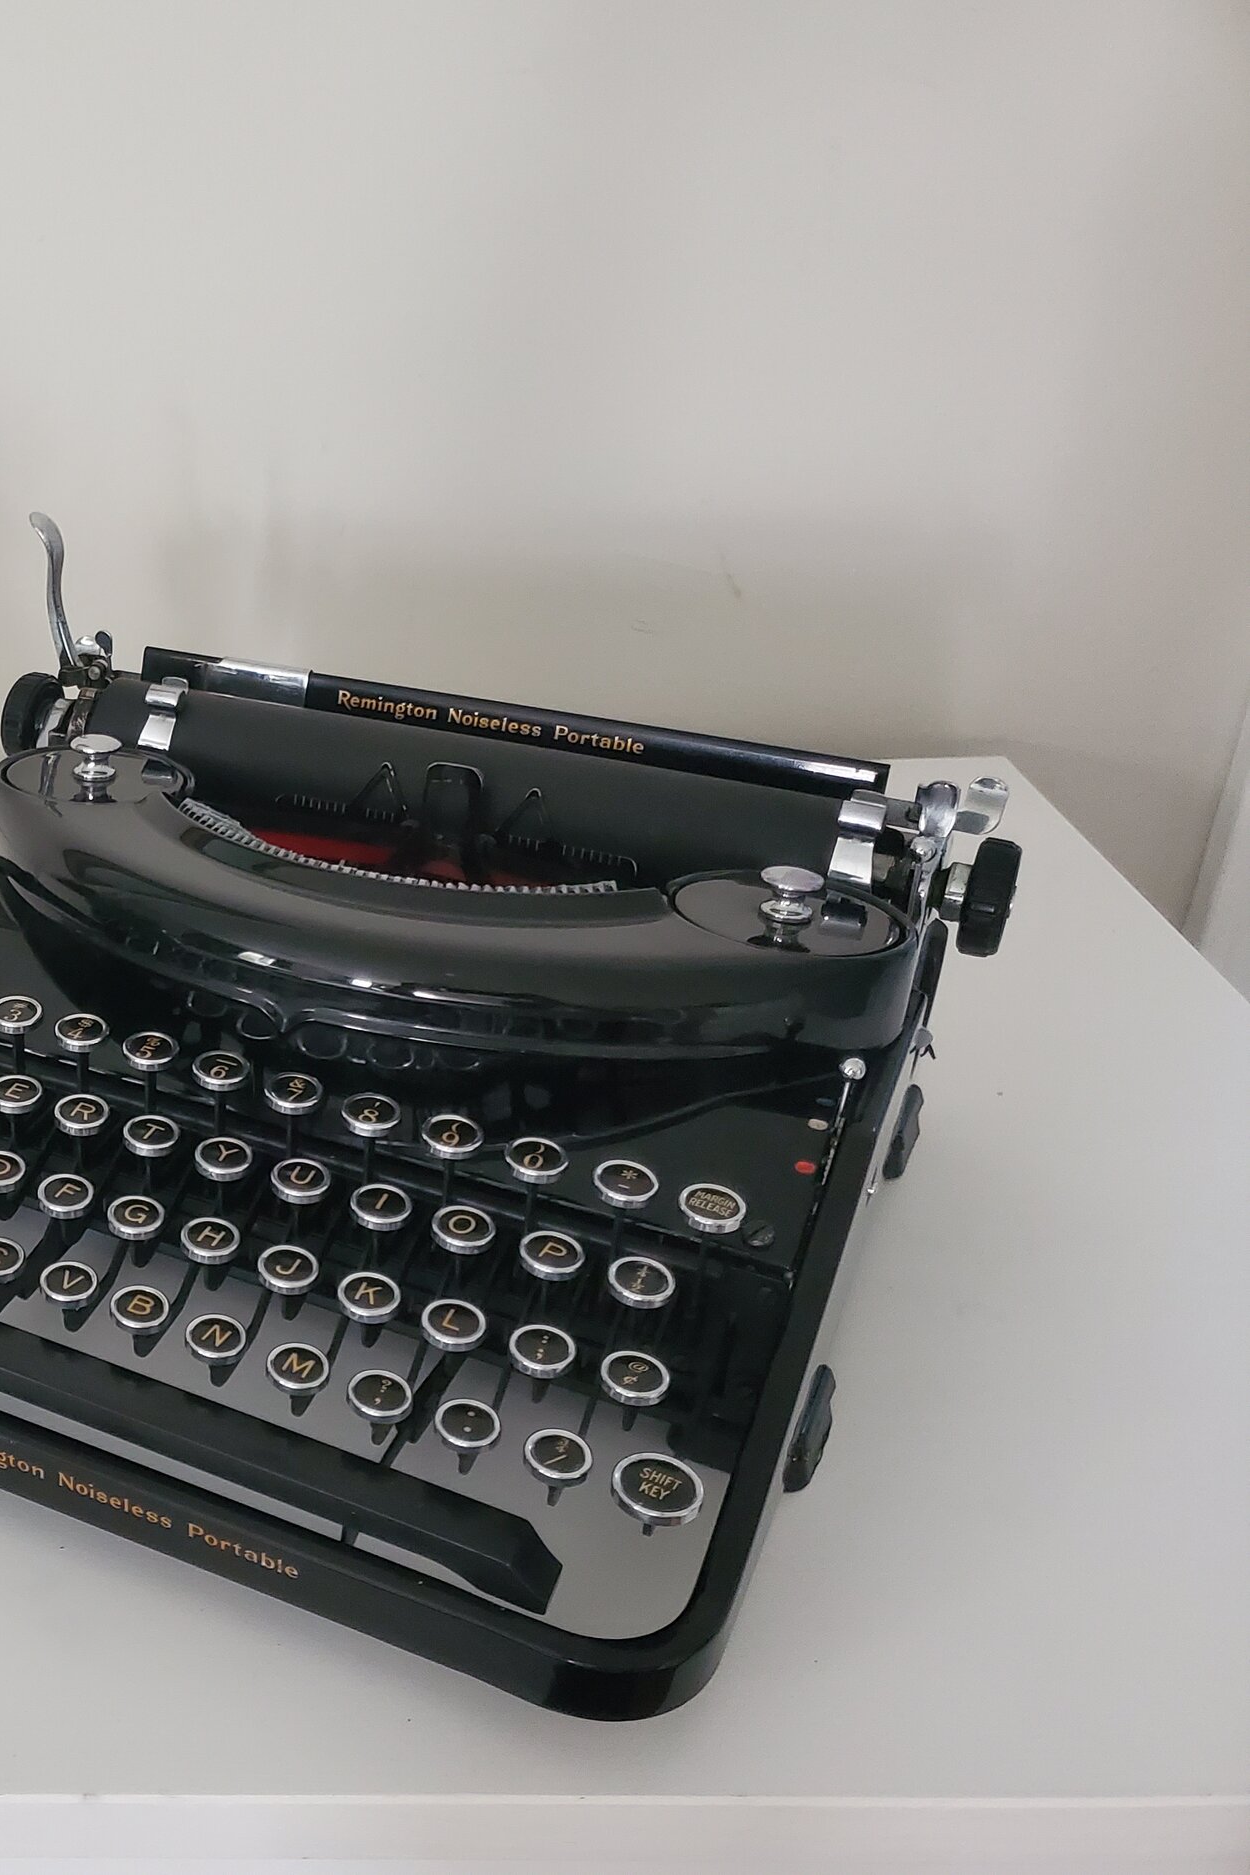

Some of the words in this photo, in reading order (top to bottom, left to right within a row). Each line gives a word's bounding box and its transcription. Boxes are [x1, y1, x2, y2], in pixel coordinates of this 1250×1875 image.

[337, 689, 438, 719] Remington
[447, 707, 542, 737] Noiseless
[553, 724, 645, 755] Portable
[4, 1009, 22, 1021] 3
[67, 1028, 83, 1039] 4
[135, 1046, 156, 1058] 5
[209, 1065, 229, 1079] 6
[4, 1082, 30, 1099] E
[287, 1087, 304, 1101] 7
[70, 1102, 96, 1120] R
[358, 1108, 379, 1123] 8
[142, 1123, 165, 1139] T
[442, 1131, 460, 1147] 9
[218, 1144, 240, 1161] Y
[290, 1166, 316, 1185] U
[54, 1183, 81, 1198] F
[694, 1190, 736, 1209] MARGIN
[375, 1193, 388, 1210] I
[688, 1197, 733, 1217] RELEASE
[124, 1204, 149, 1224] G
[448, 1214, 476, 1234] O
[196, 1225, 226, 1247] H
[538, 1241, 567, 1258] P
[275, 1258, 302, 1275] J
[63, 1269, 85, 1290] V
[354, 1281, 384, 1305] K
[126, 1294, 155, 1315] B
[442, 1308, 460, 1332] L
[201, 1324, 232, 1348] N
[281, 1352, 316, 1379] M
[639, 1467, 682, 1491] SHIFT
[638, 1481, 671, 1500] KEY
[58, 1471, 173, 1529] Noiseless
[187, 1522, 299, 1579] Portable
